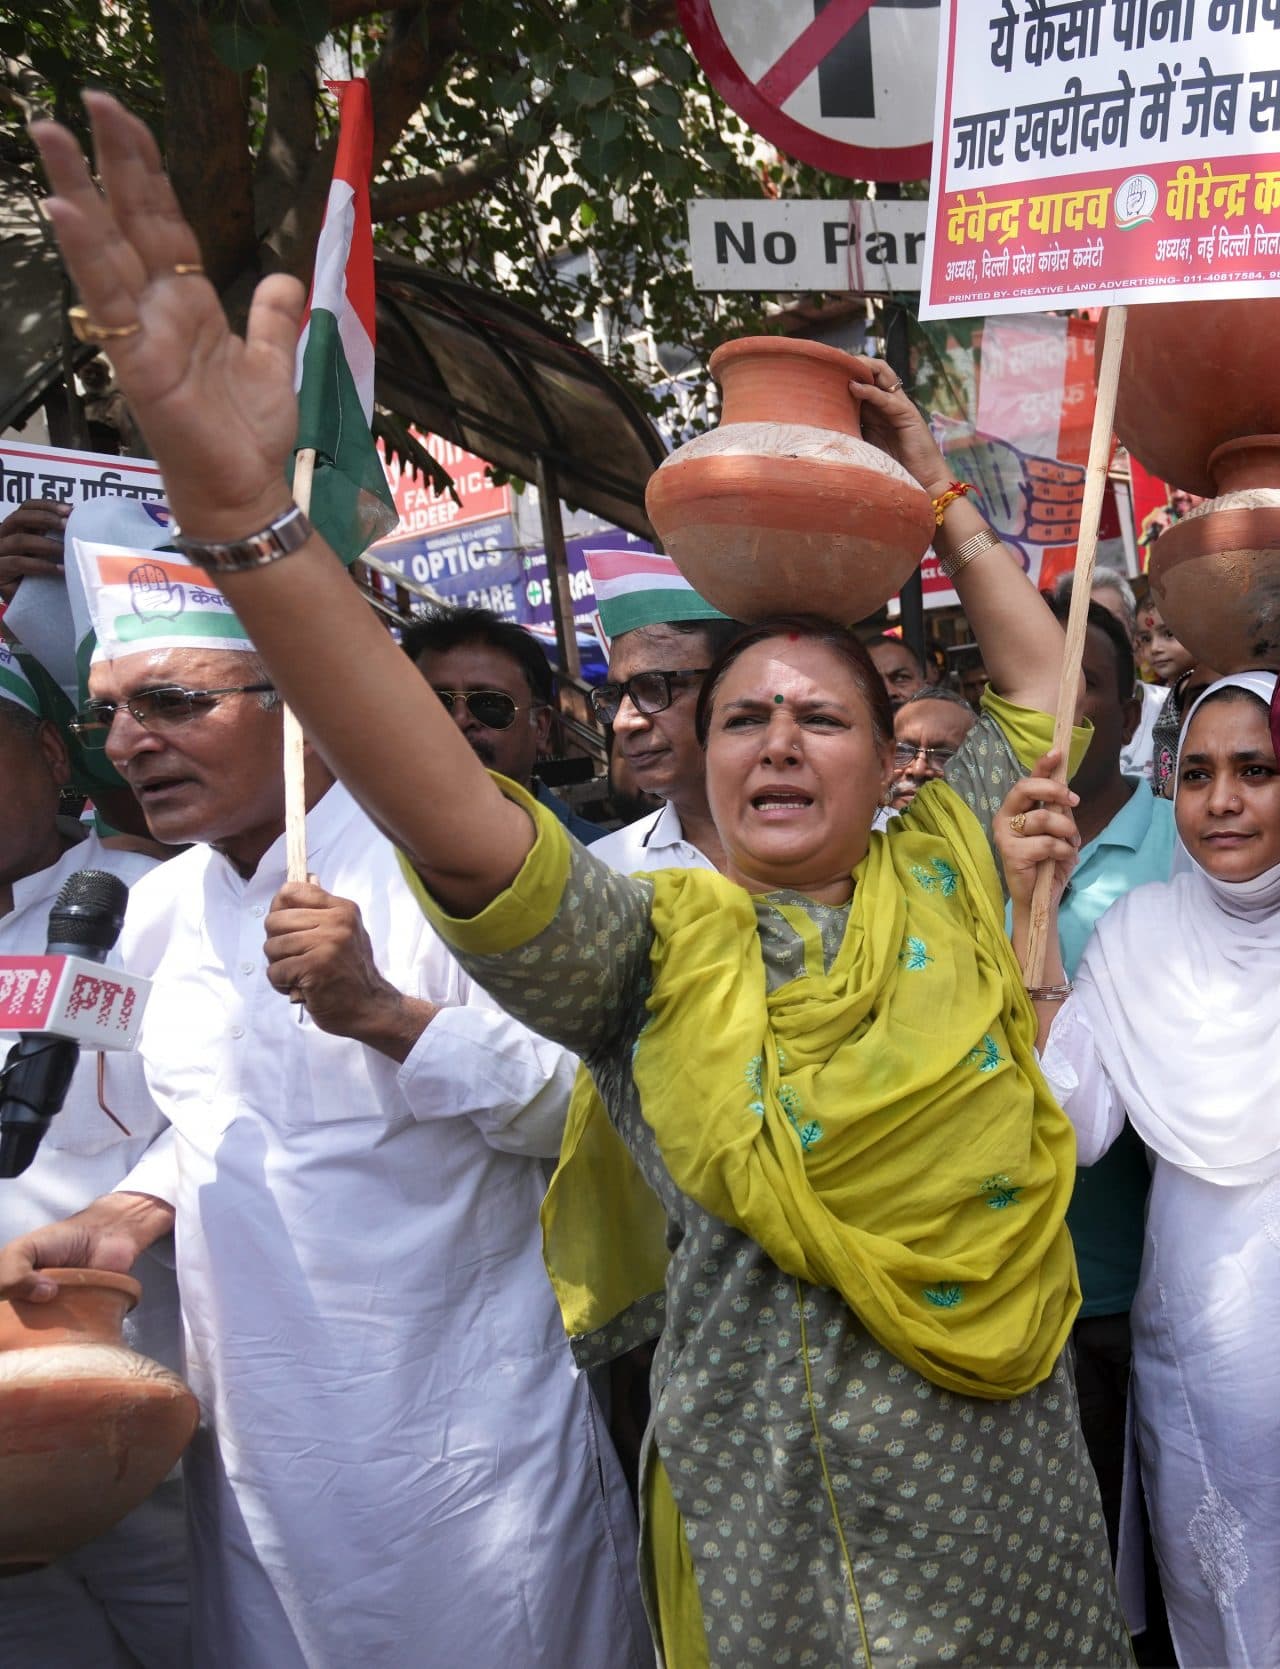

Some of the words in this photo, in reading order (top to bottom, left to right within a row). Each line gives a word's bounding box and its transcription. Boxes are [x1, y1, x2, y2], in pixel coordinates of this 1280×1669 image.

[953, 108, 1011, 171] जार
[1014, 76, 1136, 163] खरीदने
[1140, 62, 1183, 143] में
[1180, 56, 1245, 138] जेब
[1165, 161, 1251, 222] वीरेन्द्र
[946, 191, 1026, 248] देवेन्द्र
[1028, 187, 1113, 235] यादव
[714, 221, 797, 265] No
[822, 221, 927, 265] Par
[981, 247, 1010, 279] दिल्ली
[1012, 244, 1036, 277] प्रदेश
[1038, 241, 1071, 273] कांग्रेस
[1073, 237, 1105, 269] कमेटी
[1197, 225, 1216, 265] नई
[1218, 224, 1251, 258] दिल्ली
[948, 291, 991, 303] PRINTED
[993, 290, 1011, 299] BY-
[1013, 285, 1064, 298] CREATIVE
[1066, 282, 1096, 293] LAND
[411, 537, 503, 583] OPTICS
[64, 974, 137, 1031] PTI
